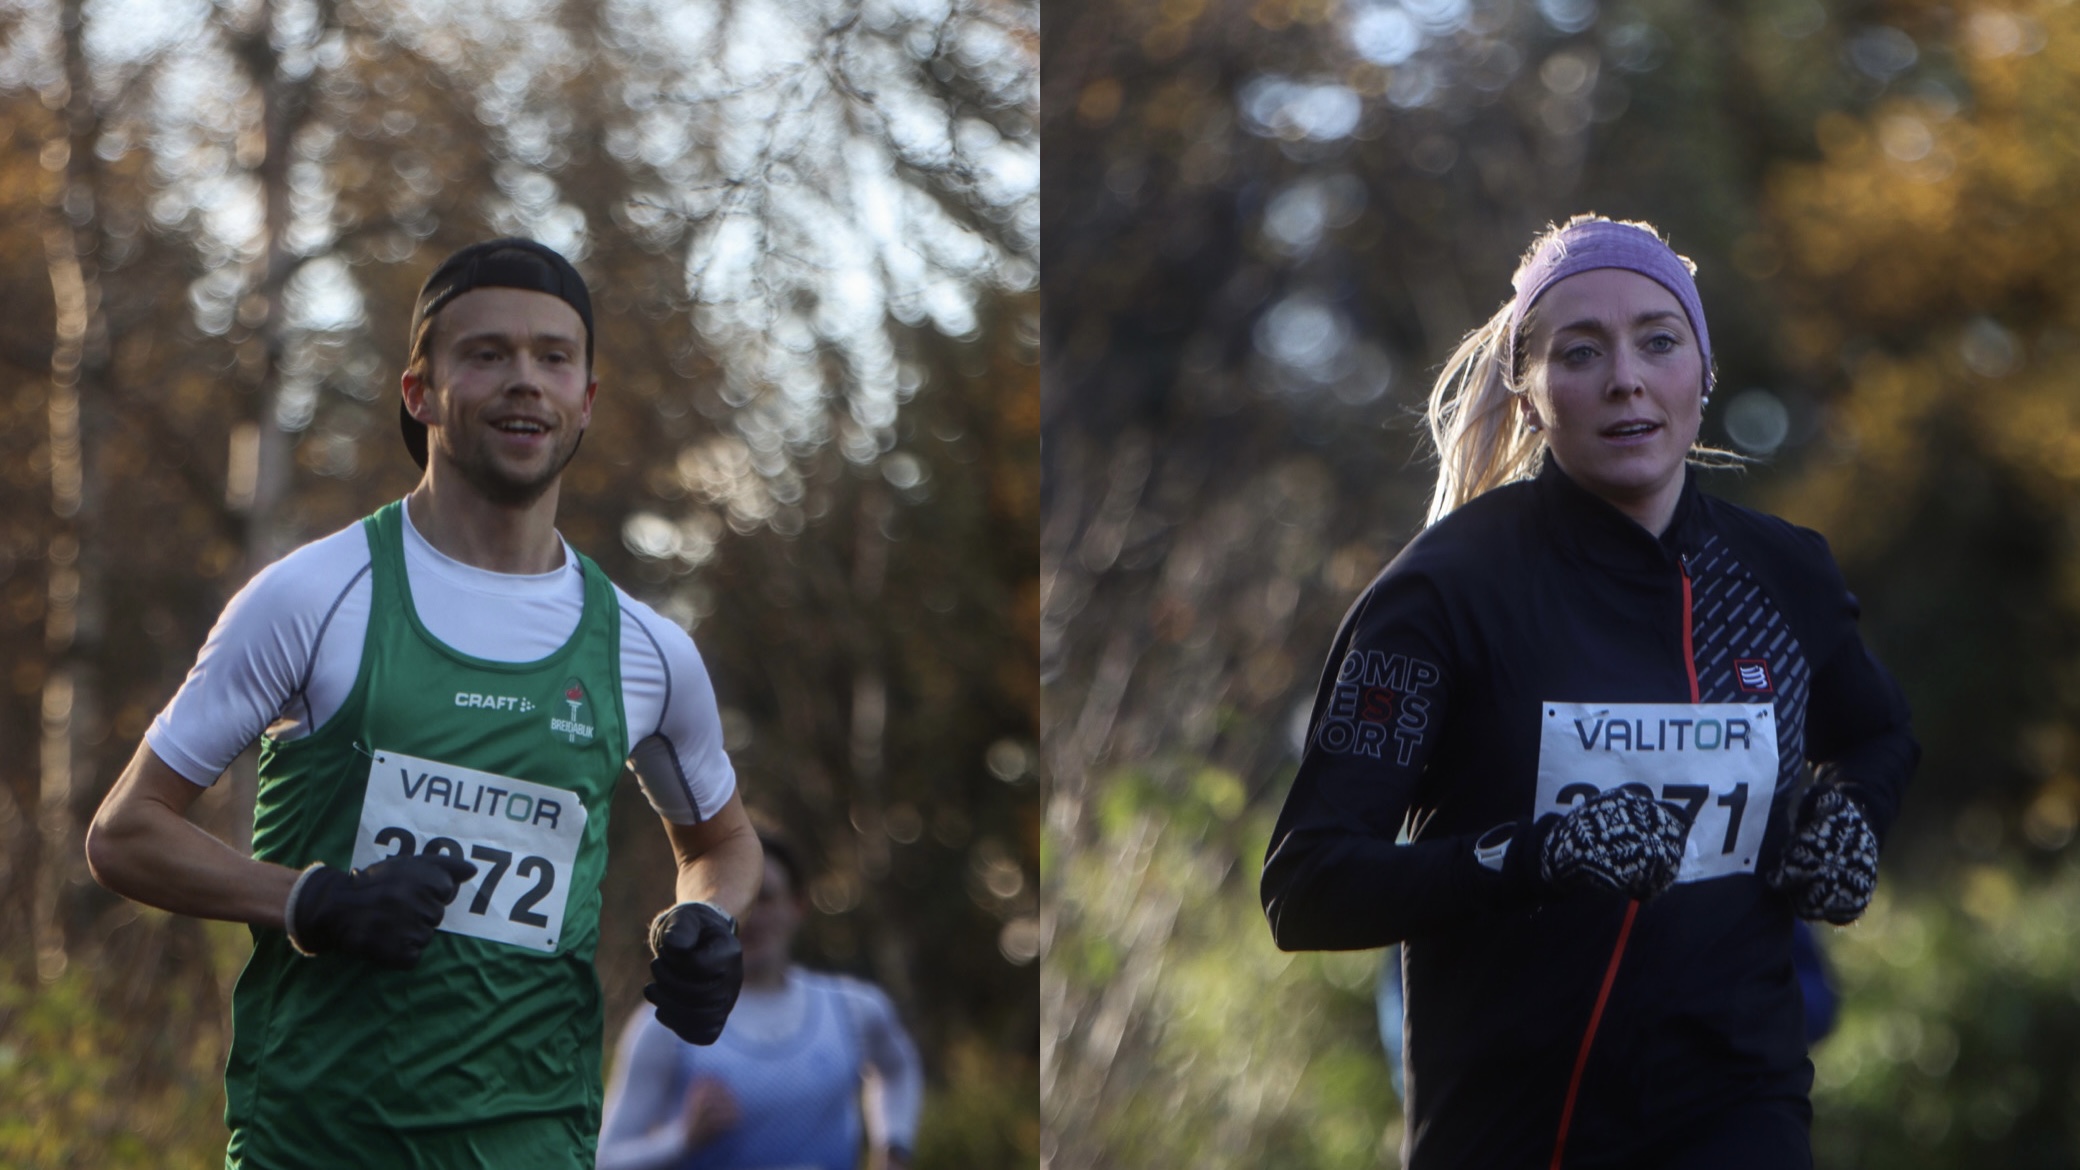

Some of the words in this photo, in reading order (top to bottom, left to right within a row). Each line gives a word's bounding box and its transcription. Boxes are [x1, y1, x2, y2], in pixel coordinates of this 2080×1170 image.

[455, 692, 518, 712] CRAFT
[1574, 718, 1751, 751] VALITOR
[400, 768, 562, 829] VALITOR
[1555, 782, 1749, 855] 71
[374, 827, 556, 929] 72
